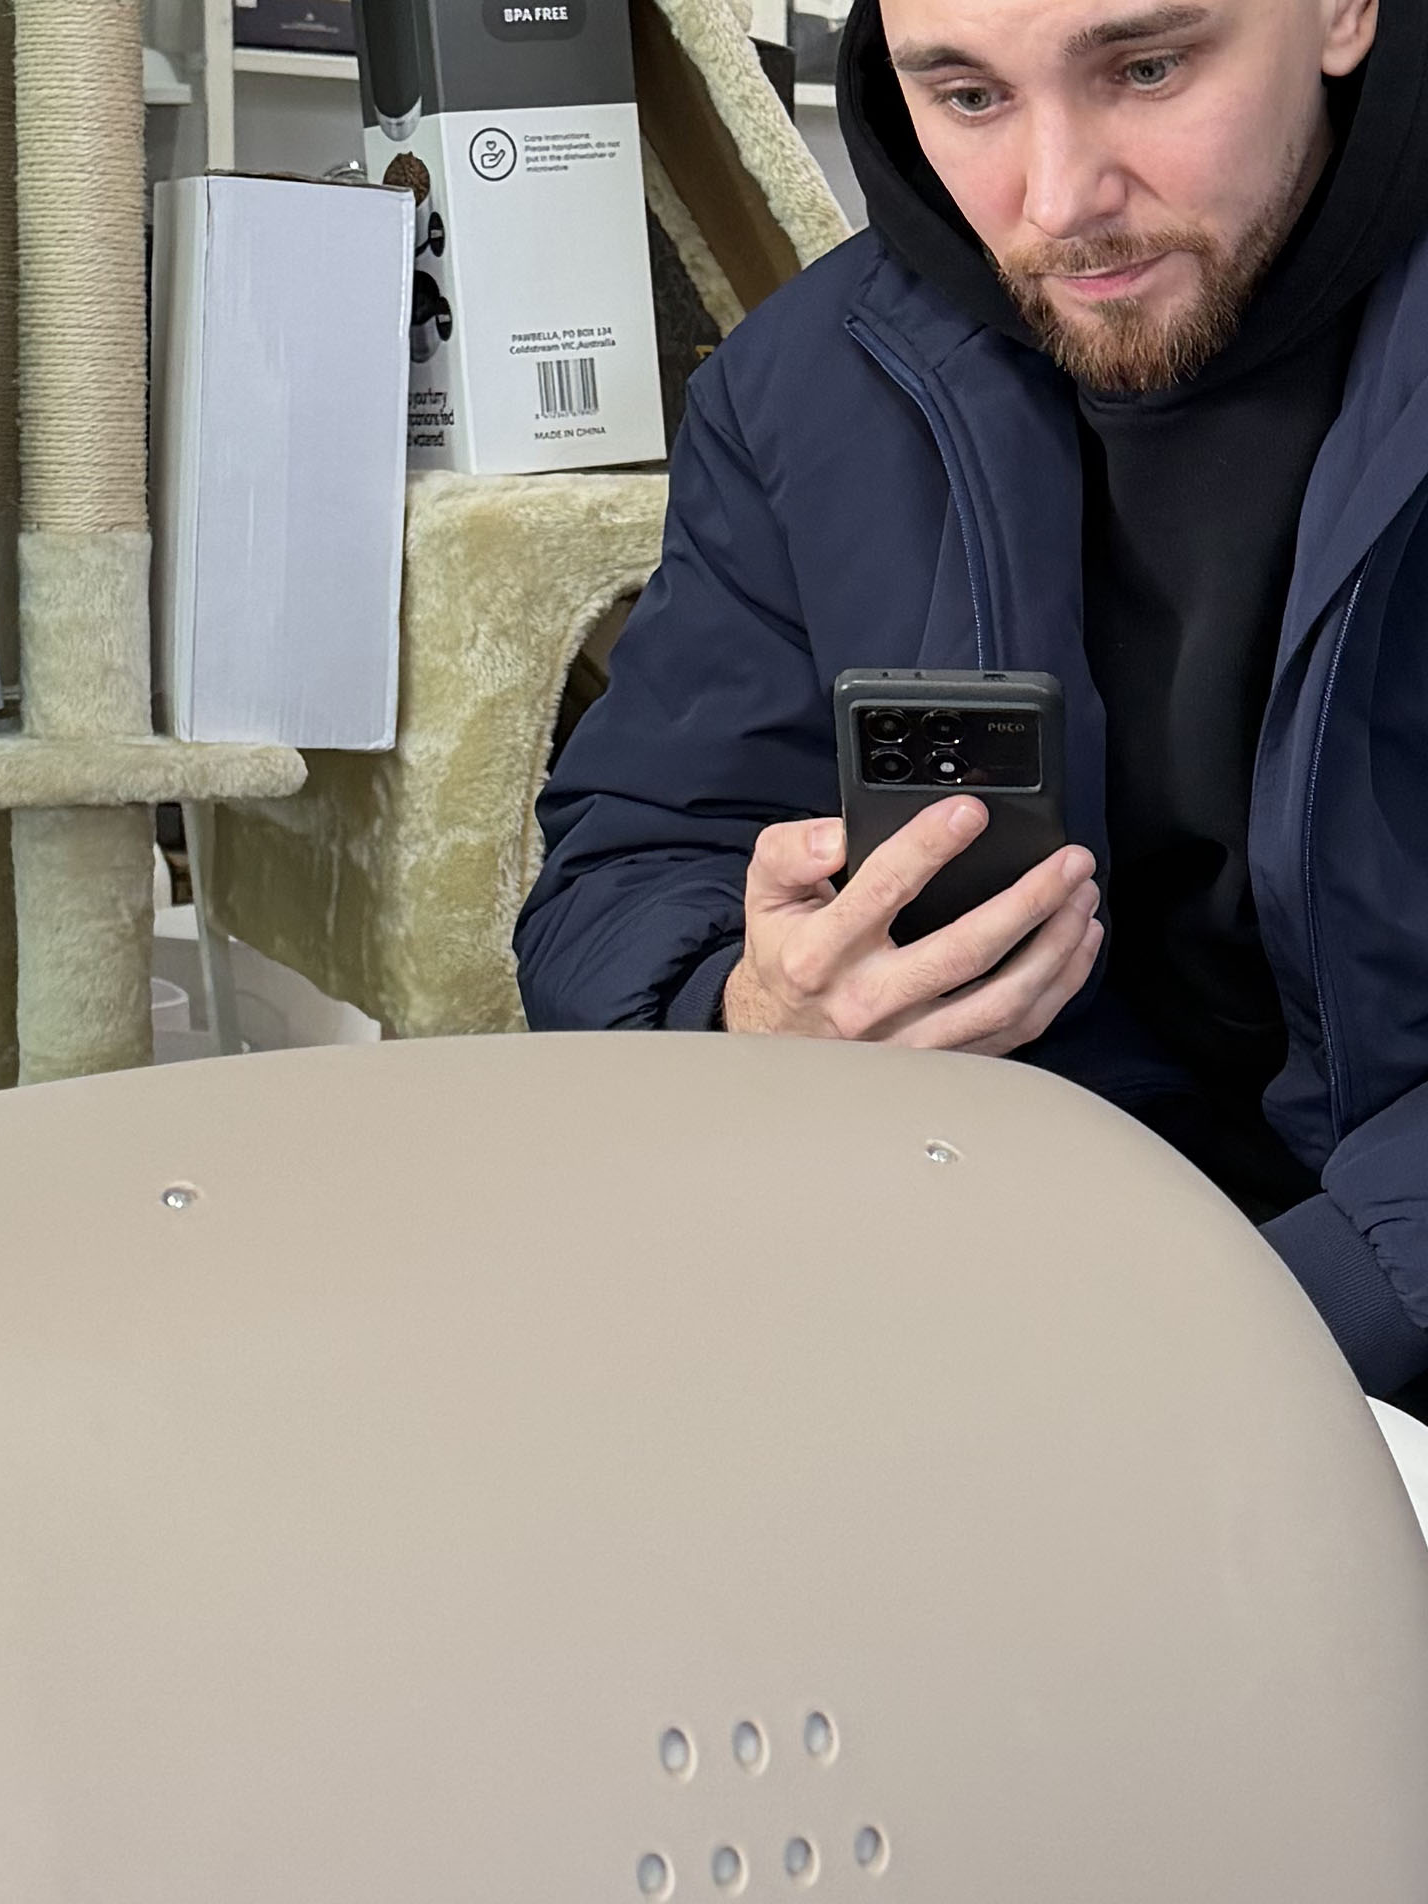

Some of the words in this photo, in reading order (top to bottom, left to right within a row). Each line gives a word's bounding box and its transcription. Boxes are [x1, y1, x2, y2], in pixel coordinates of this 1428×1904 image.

[504, 8, 533, 23] BPA
[535, 6, 568, 21] FREE
[563, 329, 575, 339] PO
[577, 328, 594, 338] BOX
[509, 342, 560, 355] Coldstream
[534, 429, 562, 440] MADE
[564, 428, 574, 438] IN
[576, 426, 606, 438] CHINA
[988, 722, 1025, 733] POCO
